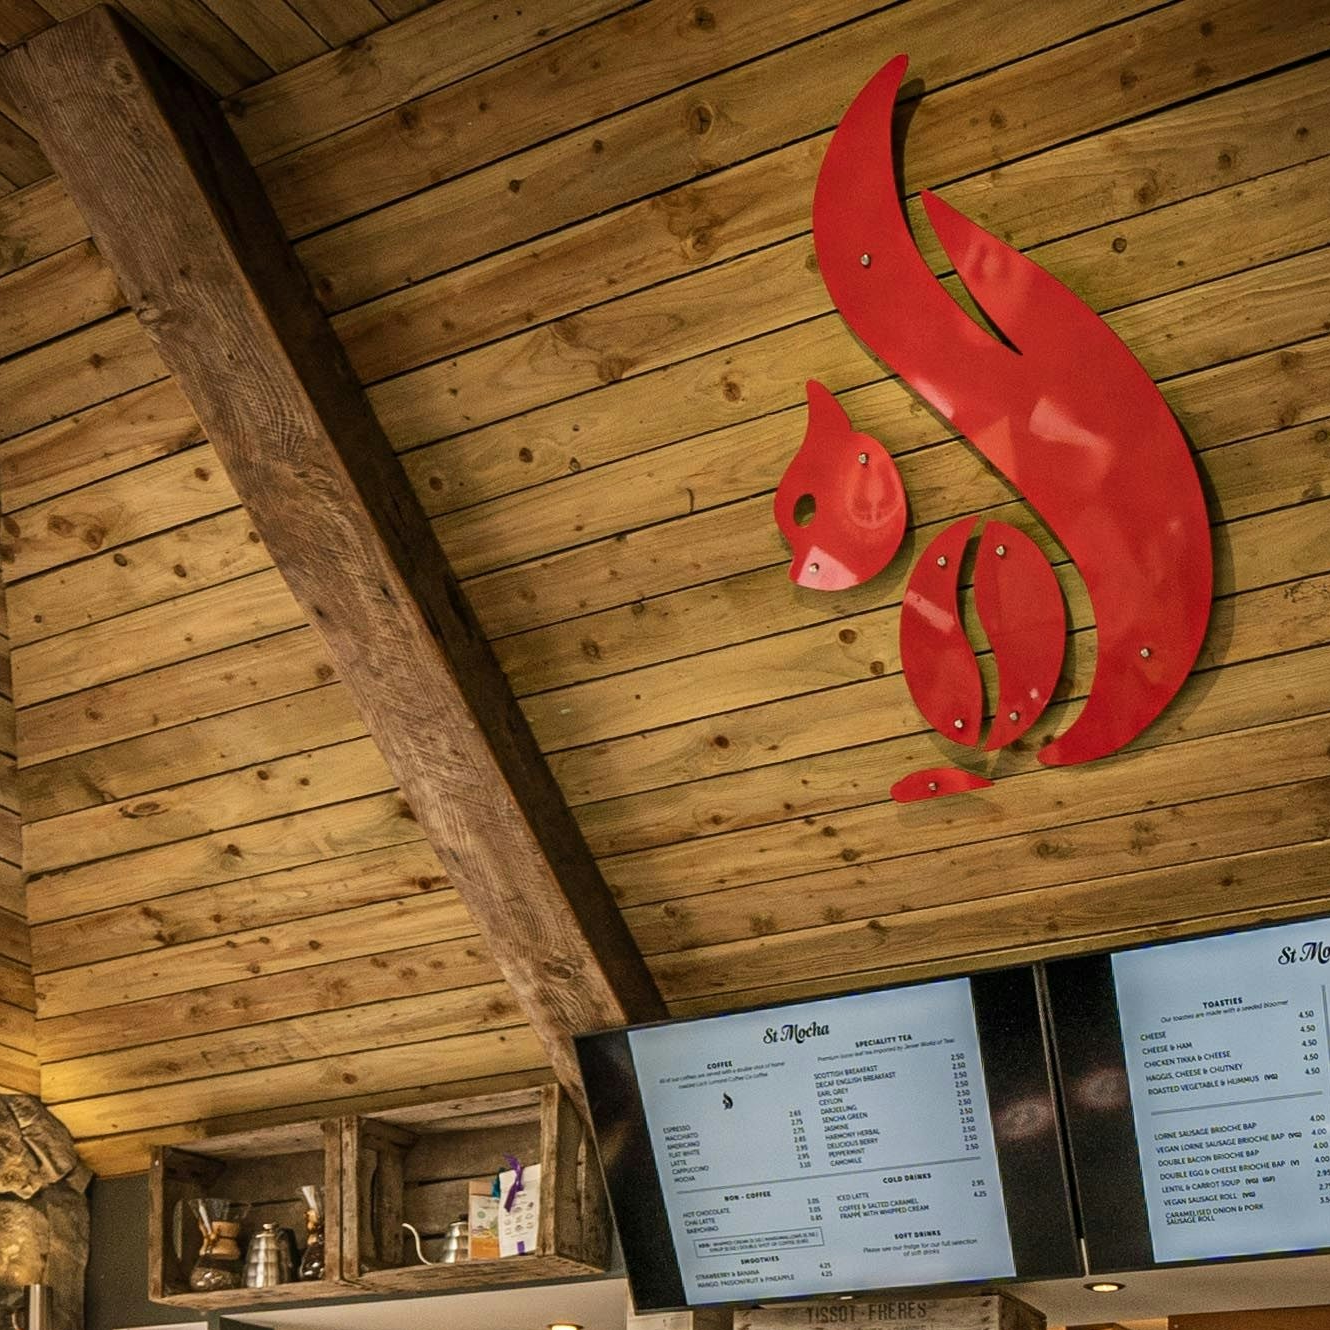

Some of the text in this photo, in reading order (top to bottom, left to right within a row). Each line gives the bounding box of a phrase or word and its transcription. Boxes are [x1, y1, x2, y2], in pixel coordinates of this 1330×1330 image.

[1278, 945, 1298, 965] St
[1202, 996, 1242, 1009] TOASTIES
[763, 1022, 829, 1044] St Mocha
[1140, 1010, 1314, 1041] CHEESE 4.50
[855, 1034, 912, 1048] SPECIALITY TEA
[1142, 1024, 1315, 1054] CHEESE & HAM 4.50
[950, 1052, 964, 1060] 2.50
[706, 1060, 733, 1070] COFFEE
